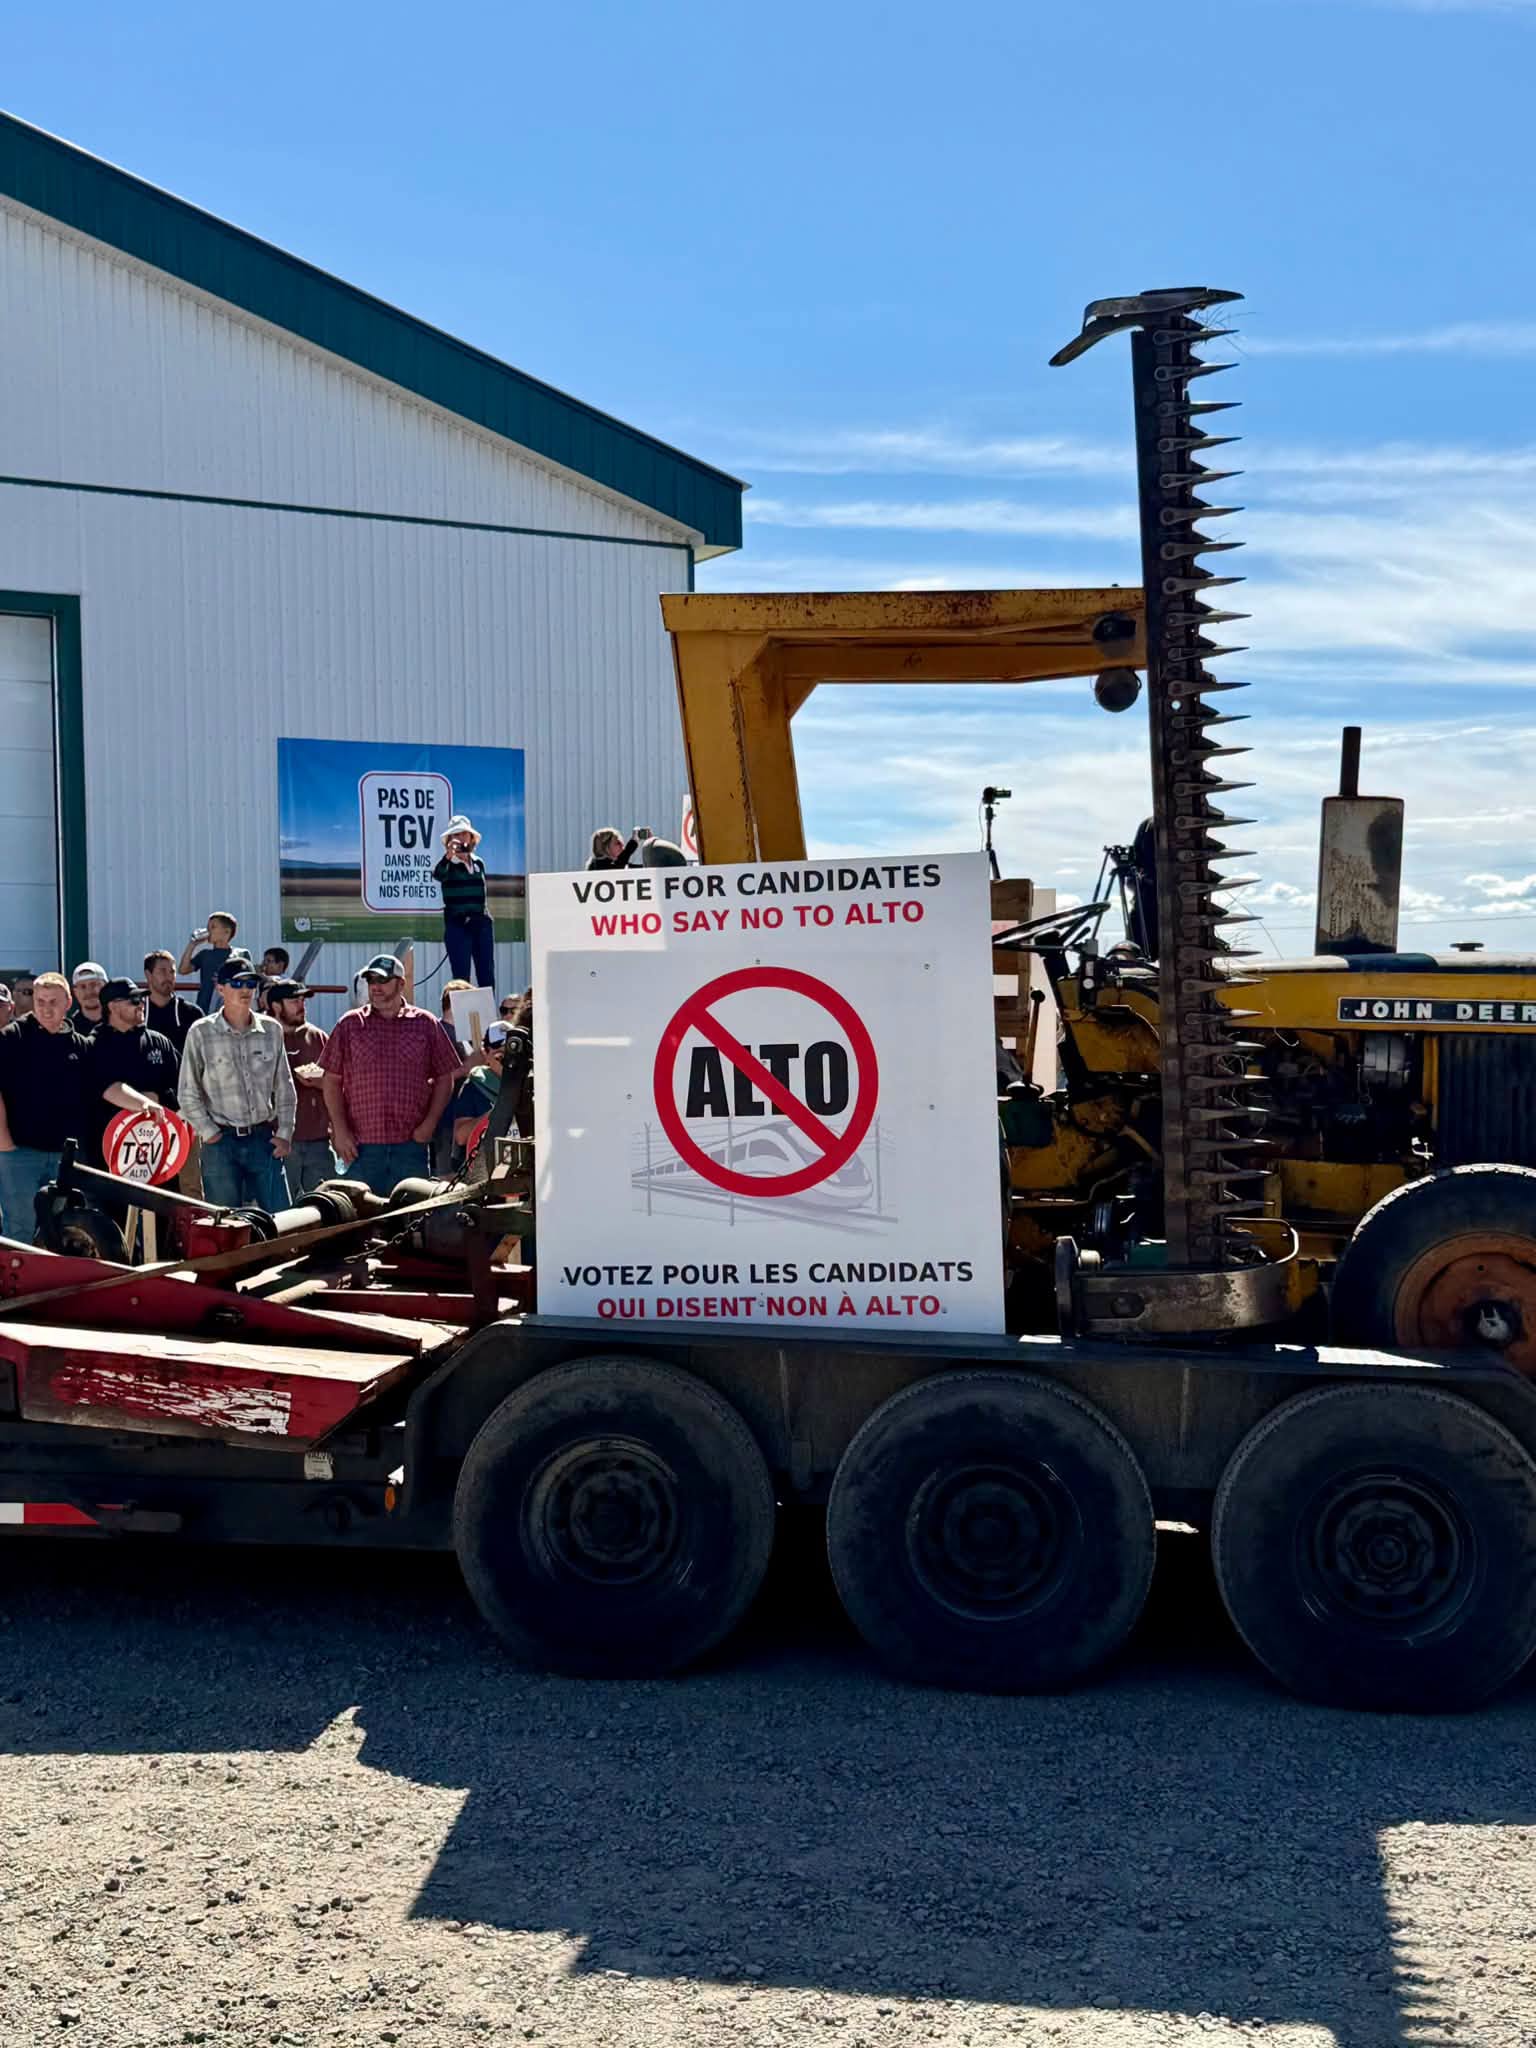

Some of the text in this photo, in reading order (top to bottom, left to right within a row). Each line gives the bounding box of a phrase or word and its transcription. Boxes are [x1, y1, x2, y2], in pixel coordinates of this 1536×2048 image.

[377, 788, 435, 809] PAS DE
[378, 814, 435, 849] TGV
[384, 854, 432, 868] DANS NOS
[381, 870, 421, 883] CHAMPS
[572, 864, 941, 904] VOTE FOR CANDIDATES
[379, 882, 437, 898] NOS FORÊTS
[591, 900, 925, 937] WHO SAY NO TO ALTO
[1354, 1001, 1536, 1021] JOHN DEER
[685, 1040, 849, 1119] ALTO
[138, 1127, 154, 1138] Stop
[123, 1142, 162, 1165] TGV
[129, 1168, 148, 1179] ALTO
[563, 1261, 973, 1287] VOTEZ POUR LES CANDIDATS
[597, 1291, 940, 1319] QUI DISENT NON À ALTO
